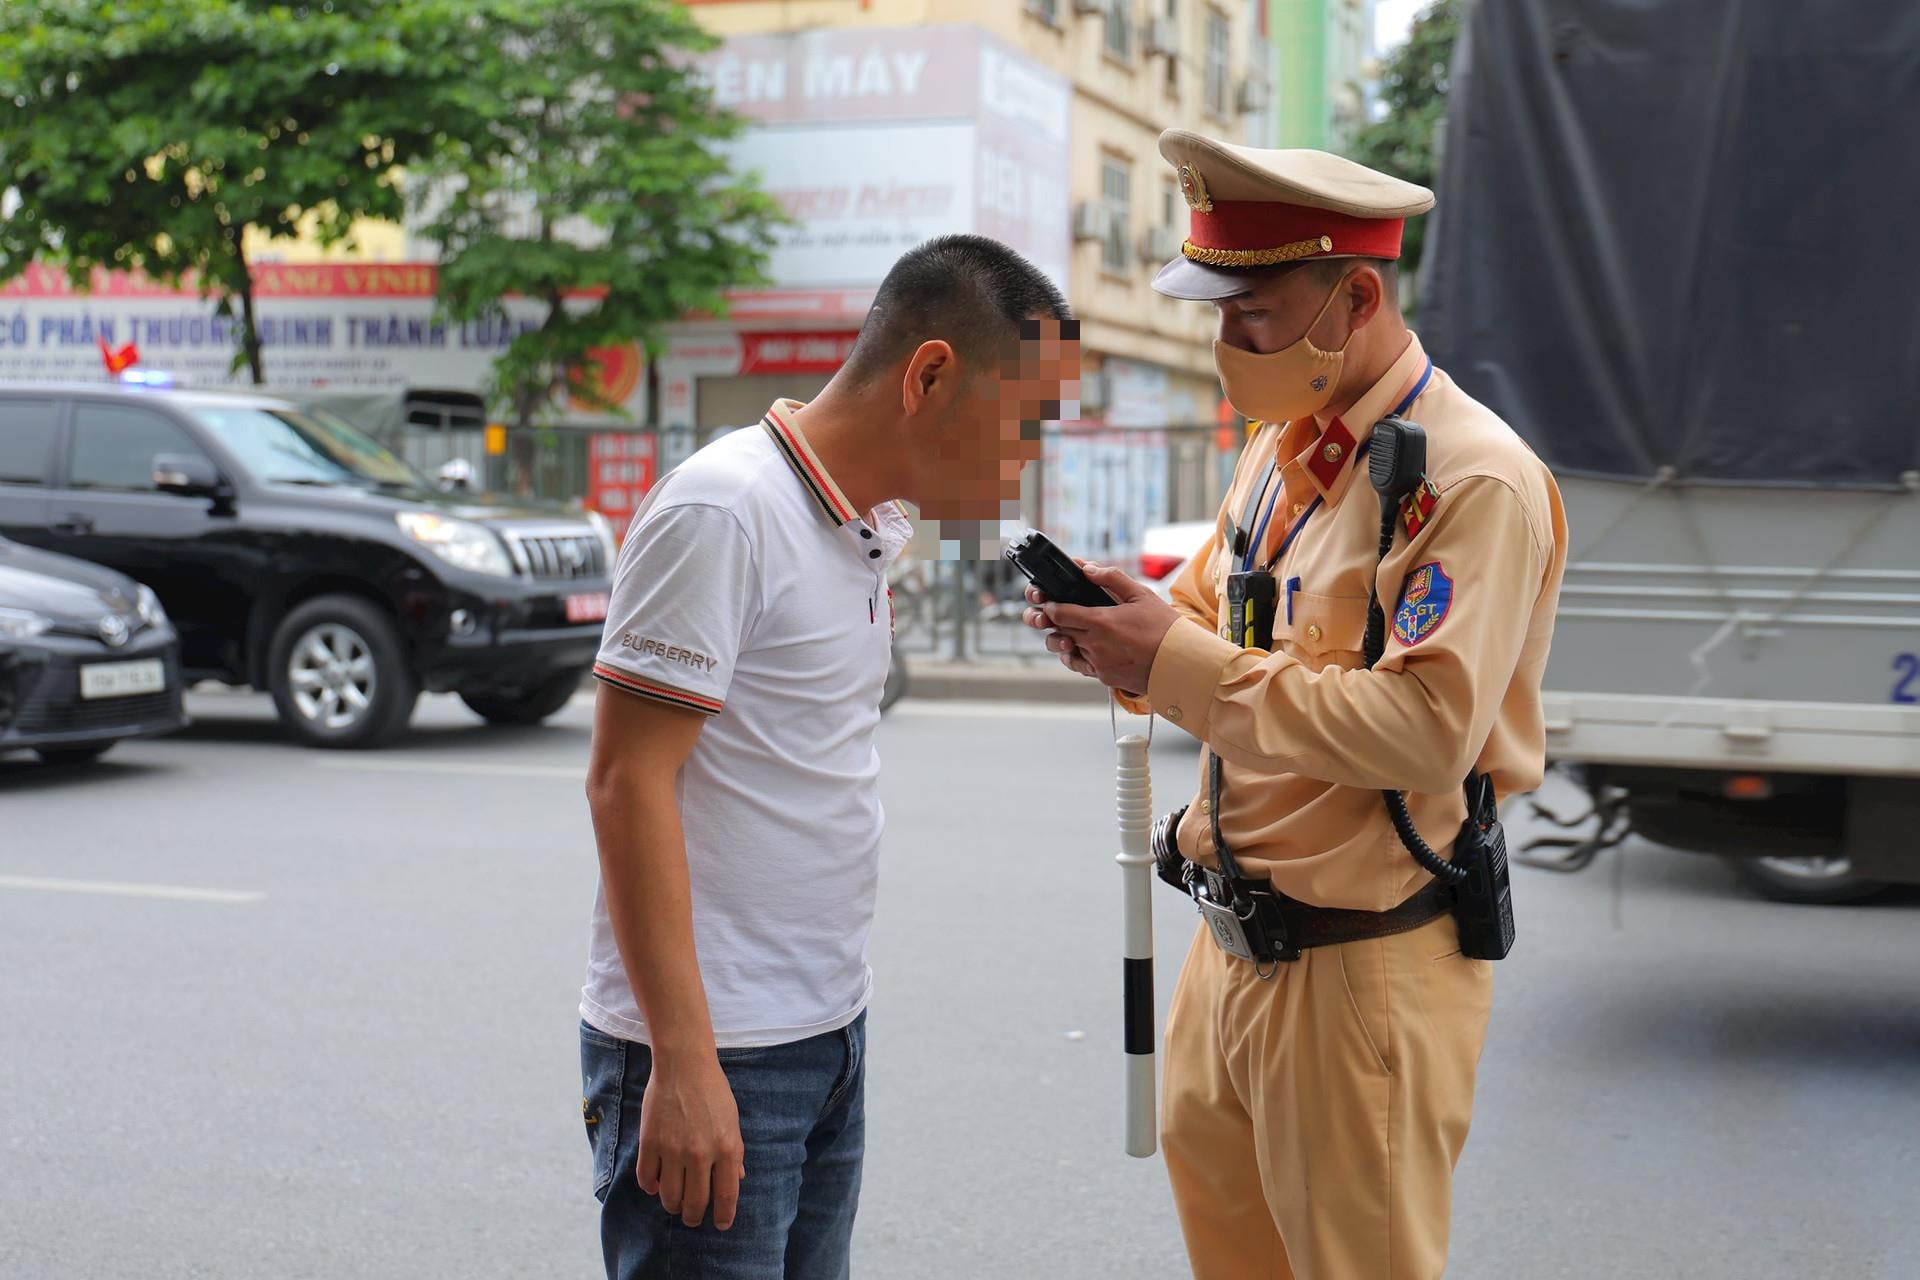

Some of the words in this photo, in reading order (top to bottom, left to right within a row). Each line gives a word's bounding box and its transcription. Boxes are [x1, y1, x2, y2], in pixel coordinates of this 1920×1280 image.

[806, 49, 924, 98] MÁY
[341, 268, 431, 293] VINH
[622, 633, 718, 672] BURBERRY
[1891, 652, 1920, 703] 2
